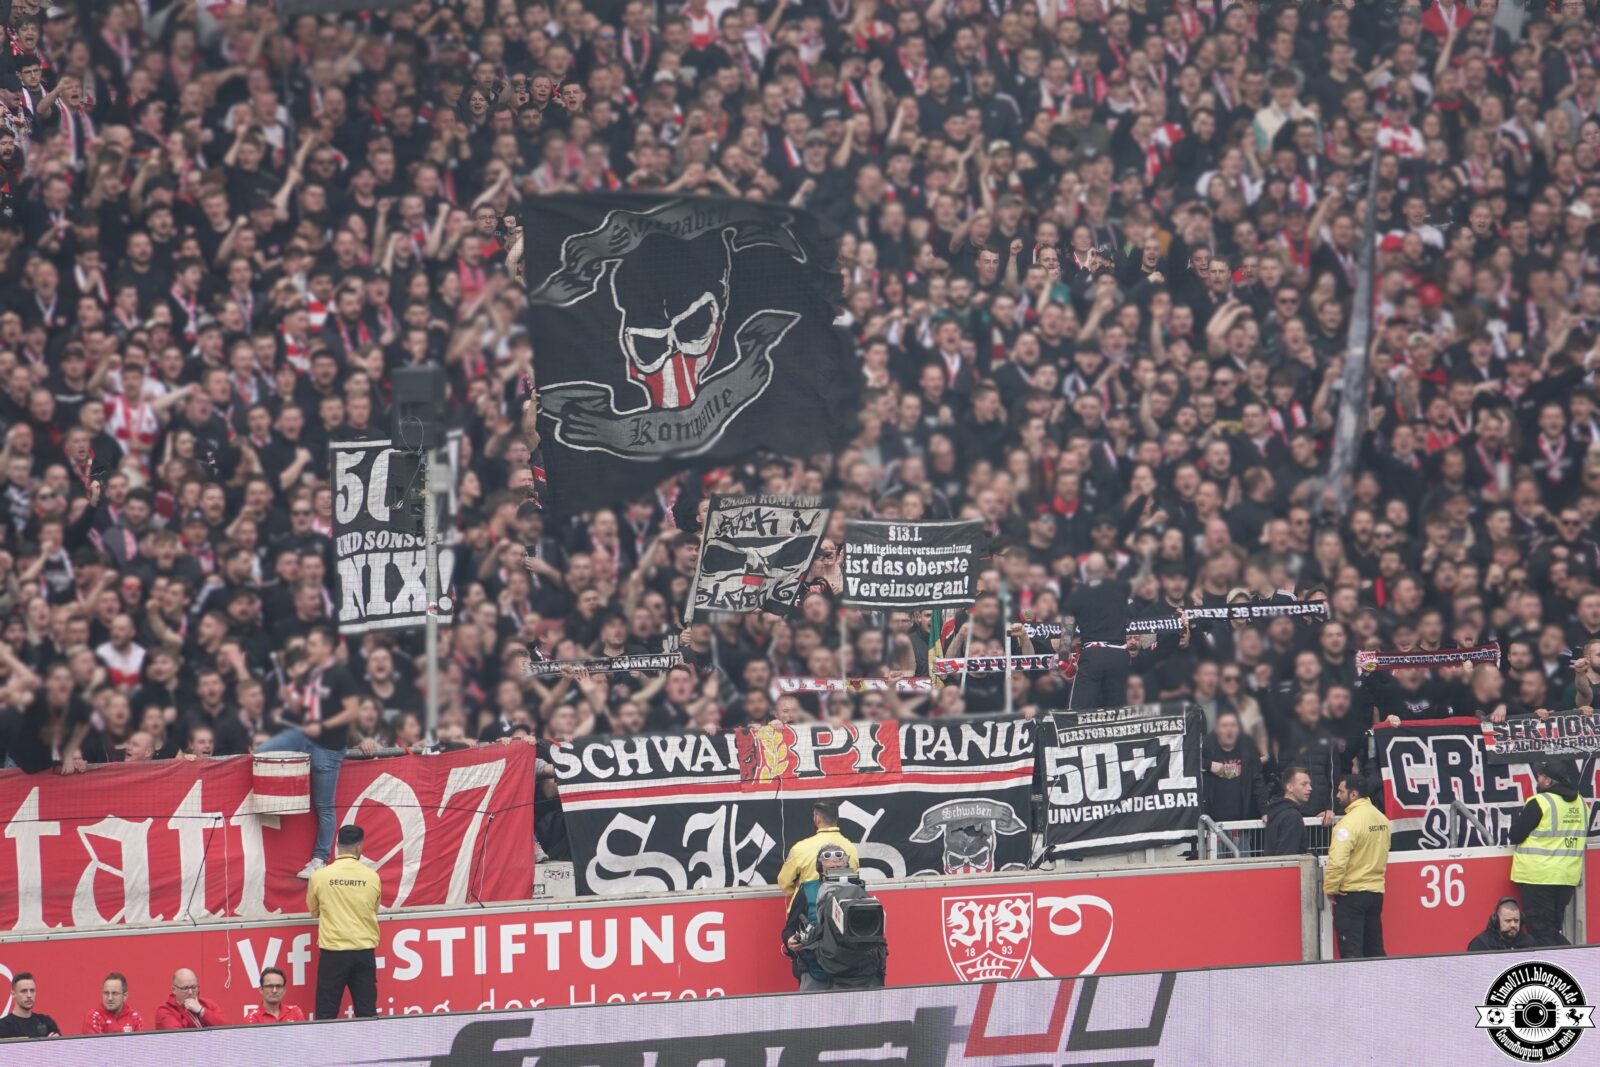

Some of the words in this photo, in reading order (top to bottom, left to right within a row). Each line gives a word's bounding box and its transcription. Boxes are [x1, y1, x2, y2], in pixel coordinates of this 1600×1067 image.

[845, 543, 862, 554] Die
[863, 543, 972, 556] Mitgliederversammlung
[845, 555, 869, 574] ist
[872, 556, 903, 575] das
[906, 557, 969, 576] oberste
[337, 551, 455, 622] NIX!
[846, 575, 969, 600] Vereinsorgan!
[1185, 606, 1229, 619] CREW
[1252, 603, 1326, 617] STUTTGART
[1126, 615, 1184, 633] ompanie
[1077, 710, 1116, 725] EHRE
[1492, 714, 1600, 742] SEKTION
[1058, 724, 1142, 744] VERSTORBENEN
[1142, 719, 1184, 734] ULTRAS
[1044, 735, 1198, 806] 50+1
[942, 805, 992, 819] Schwaben
[1048, 792, 1199, 825] UNVERHANDELBAR
[340, 758, 507, 909] 97
[329, 879, 367, 887] SECURITY
[1420, 863, 1465, 909] 36
[236, 911, 726, 988] Vf-STIFTUNG
[965, 948, 976, 957] 18
[1001, 945, 1013, 955] 93
